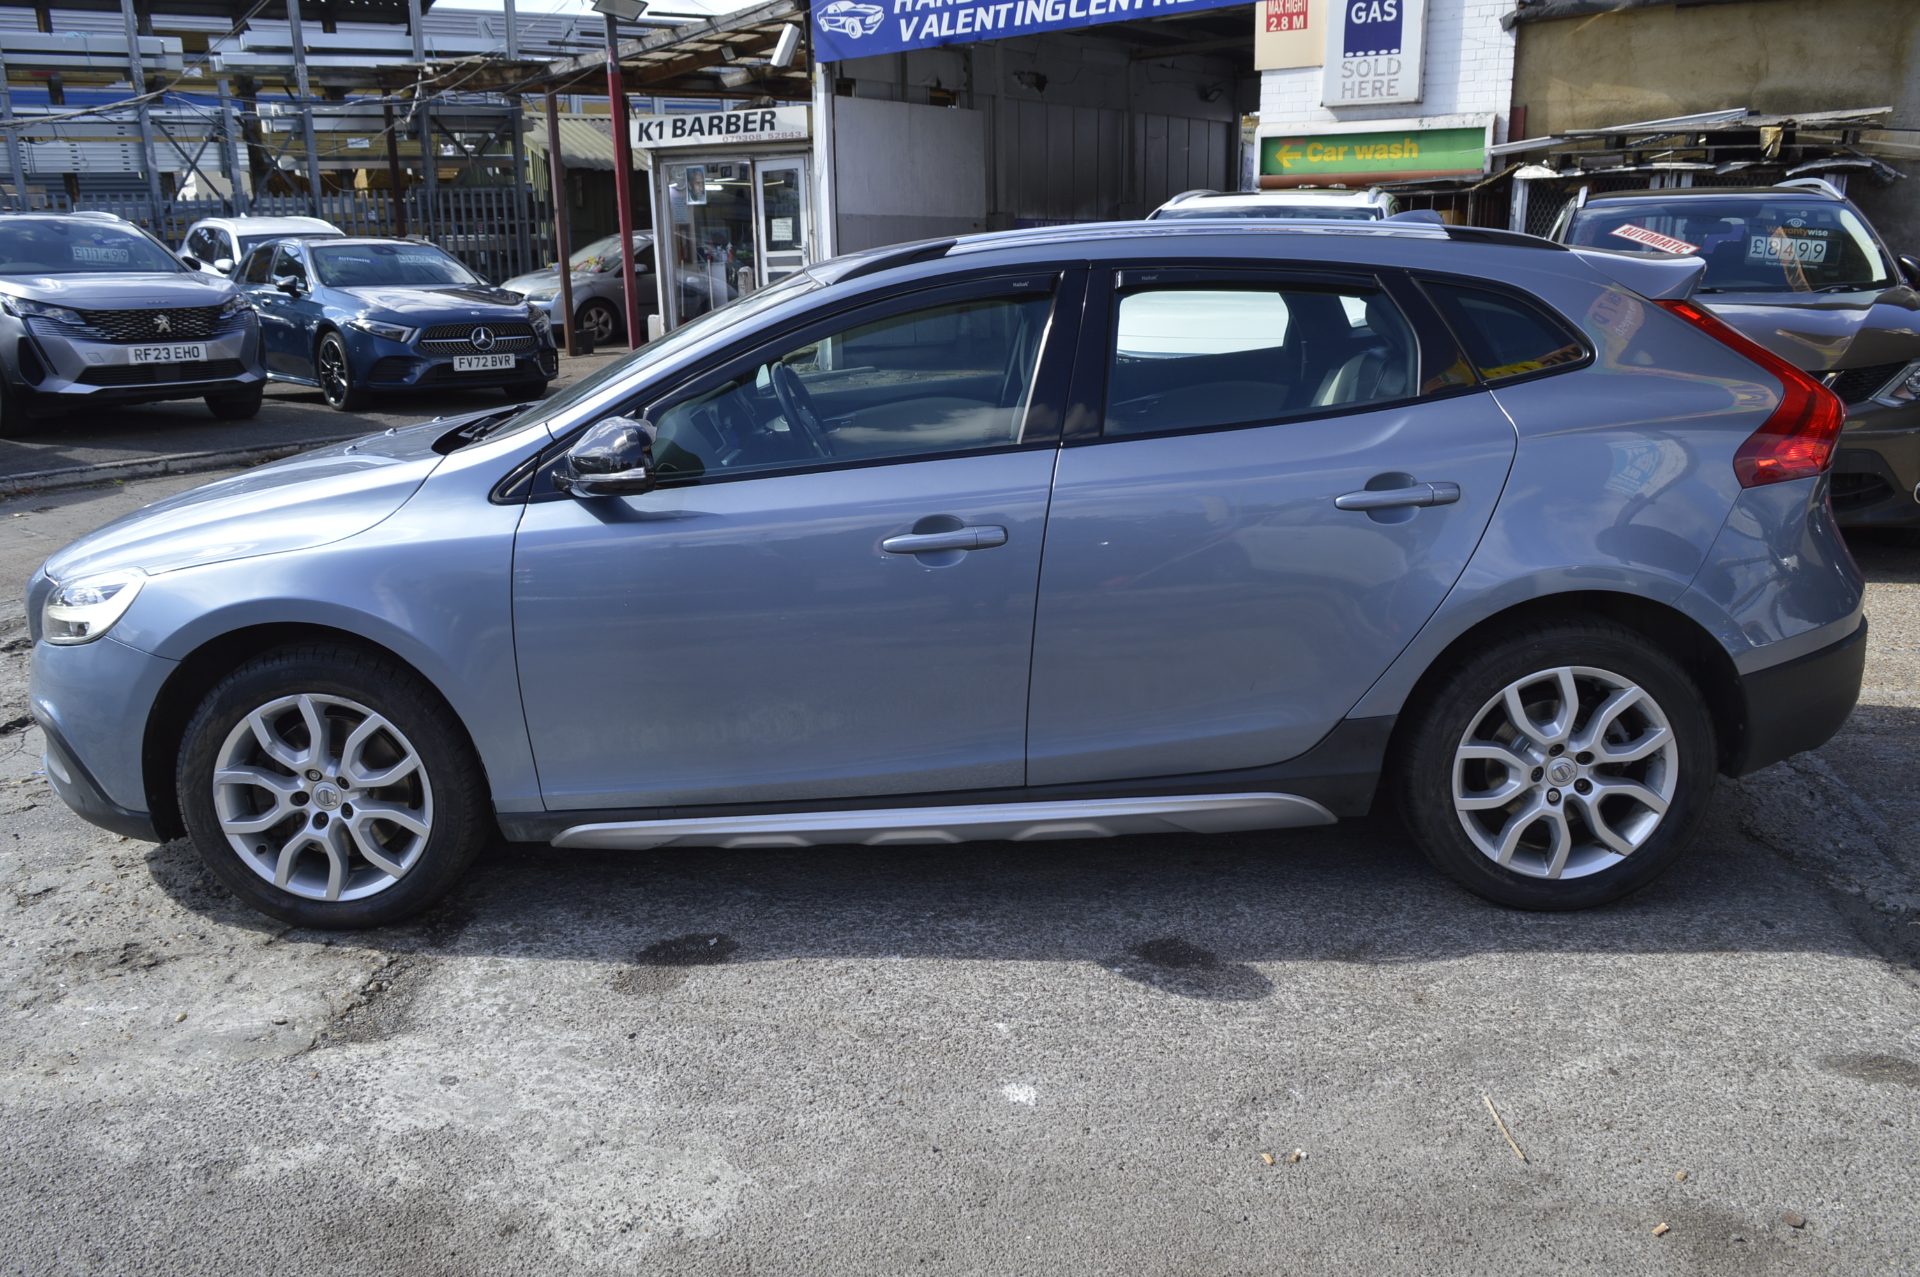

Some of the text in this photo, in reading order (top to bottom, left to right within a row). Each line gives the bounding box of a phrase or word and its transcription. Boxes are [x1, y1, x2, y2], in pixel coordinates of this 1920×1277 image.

[1268, 0, 1284, 15] MAX
[1351, 0, 1397, 24] GAS
[899, 0, 1066, 42] VALENTING
[1269, 15, 1304, 31] 2.8 M
[1341, 58, 1401, 79] SOLD
[1341, 79, 1399, 99] HERE
[638, 110, 777, 143] K1 BARBER
[1306, 138, 1419, 163] Car wash
[1618, 226, 1691, 254] AUTOMATIC
[1752, 238, 1824, 259] £8499
[134, 345, 200, 361] RF23 EHO
[458, 354, 512, 369] FV72 BVR
